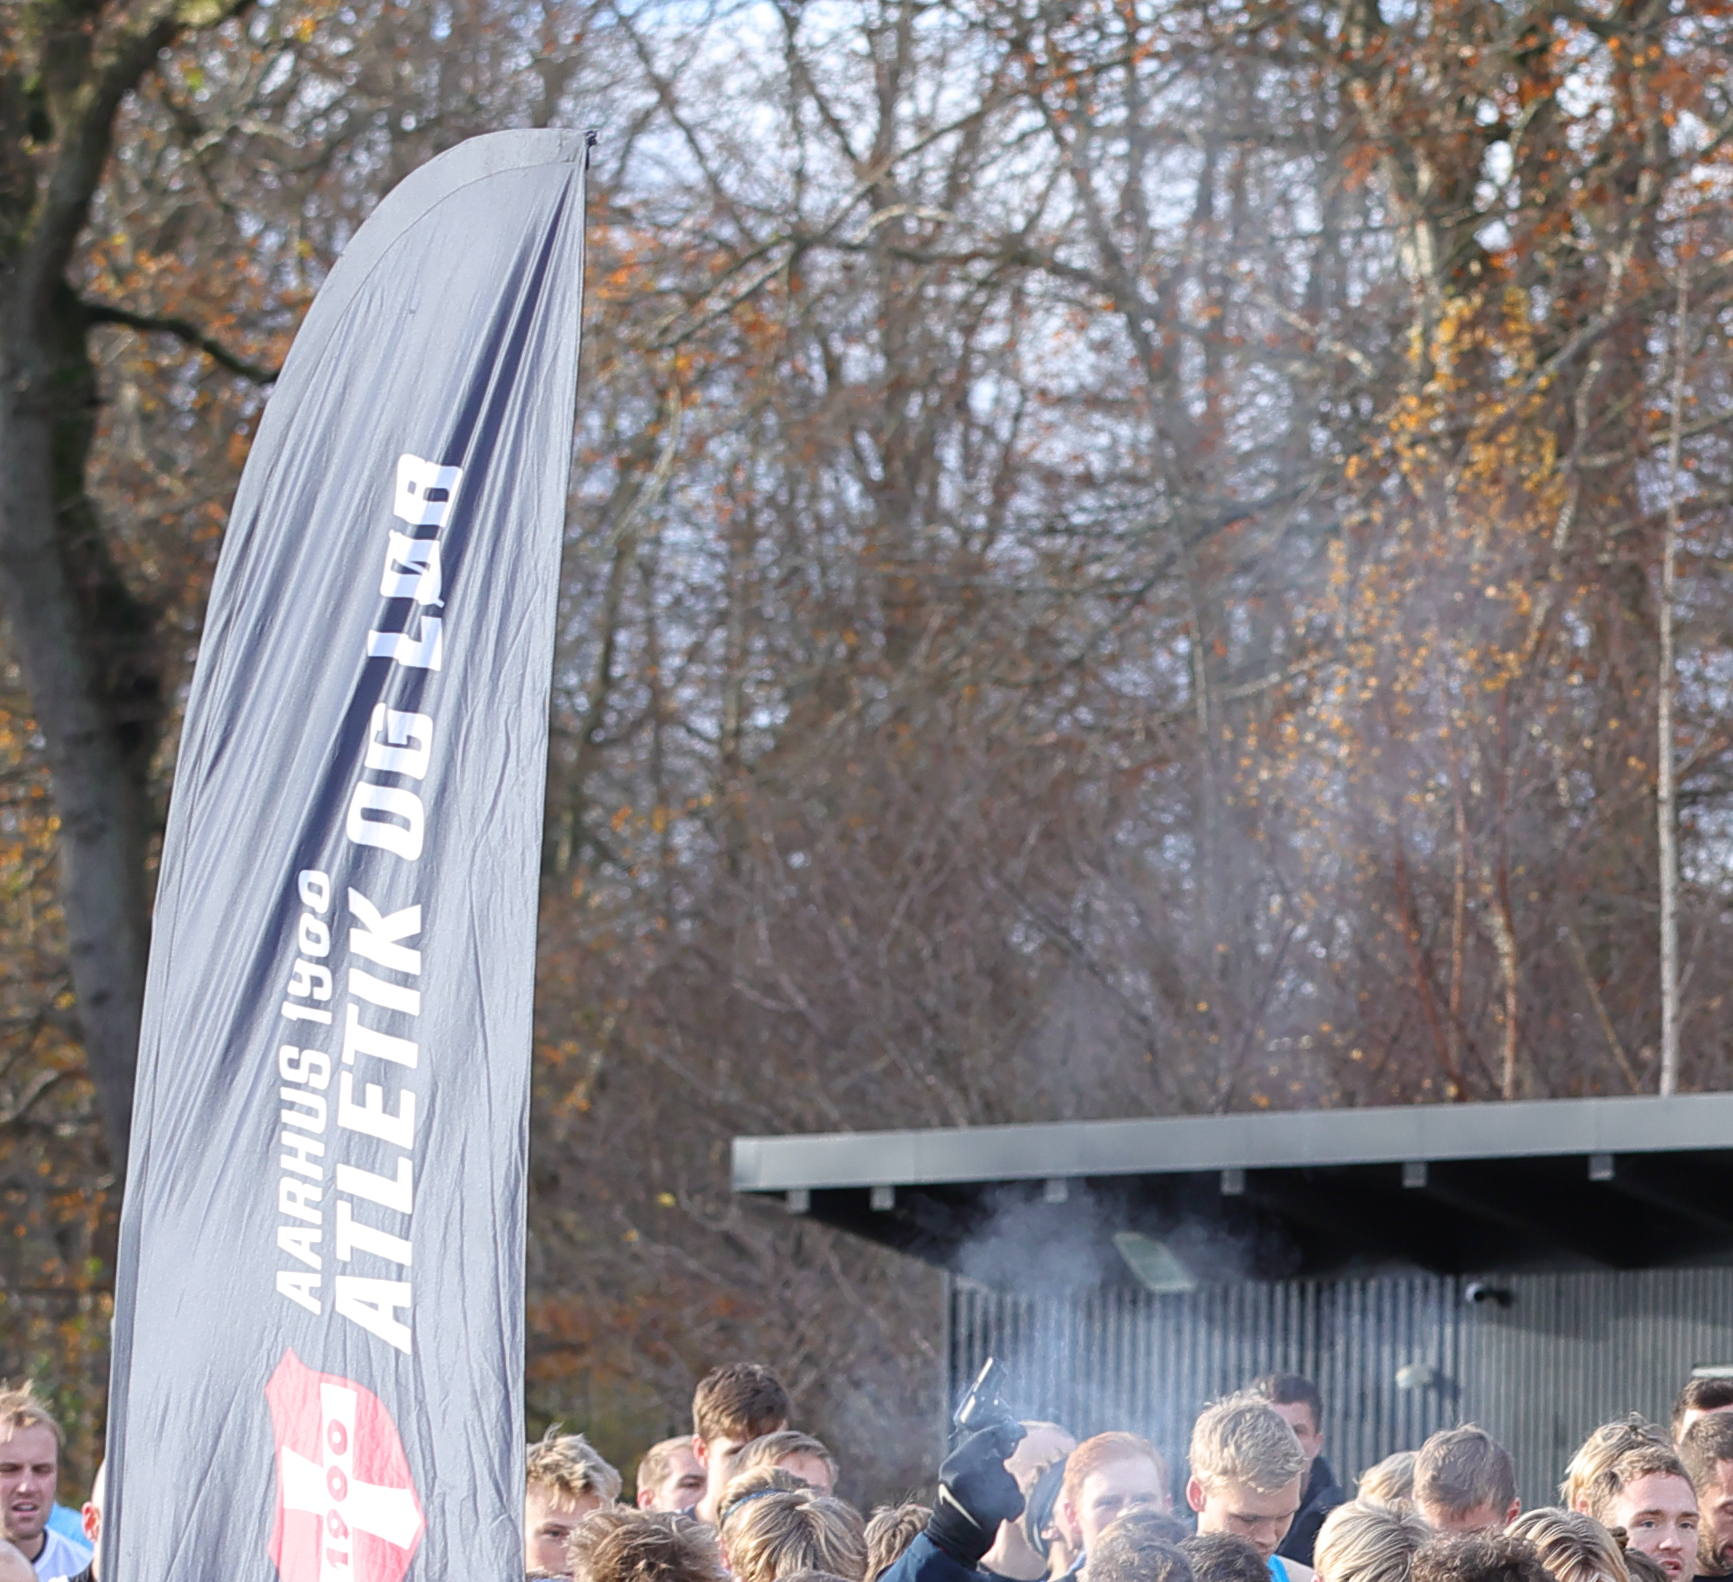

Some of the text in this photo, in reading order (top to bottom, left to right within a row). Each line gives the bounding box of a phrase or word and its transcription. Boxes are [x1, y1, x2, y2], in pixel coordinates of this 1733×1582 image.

[335, 452, 464, 1355] ATLETIK OG LØB
[275, 1043, 333, 1316] AARHUS
[326, 1419, 349, 1569] 1900
